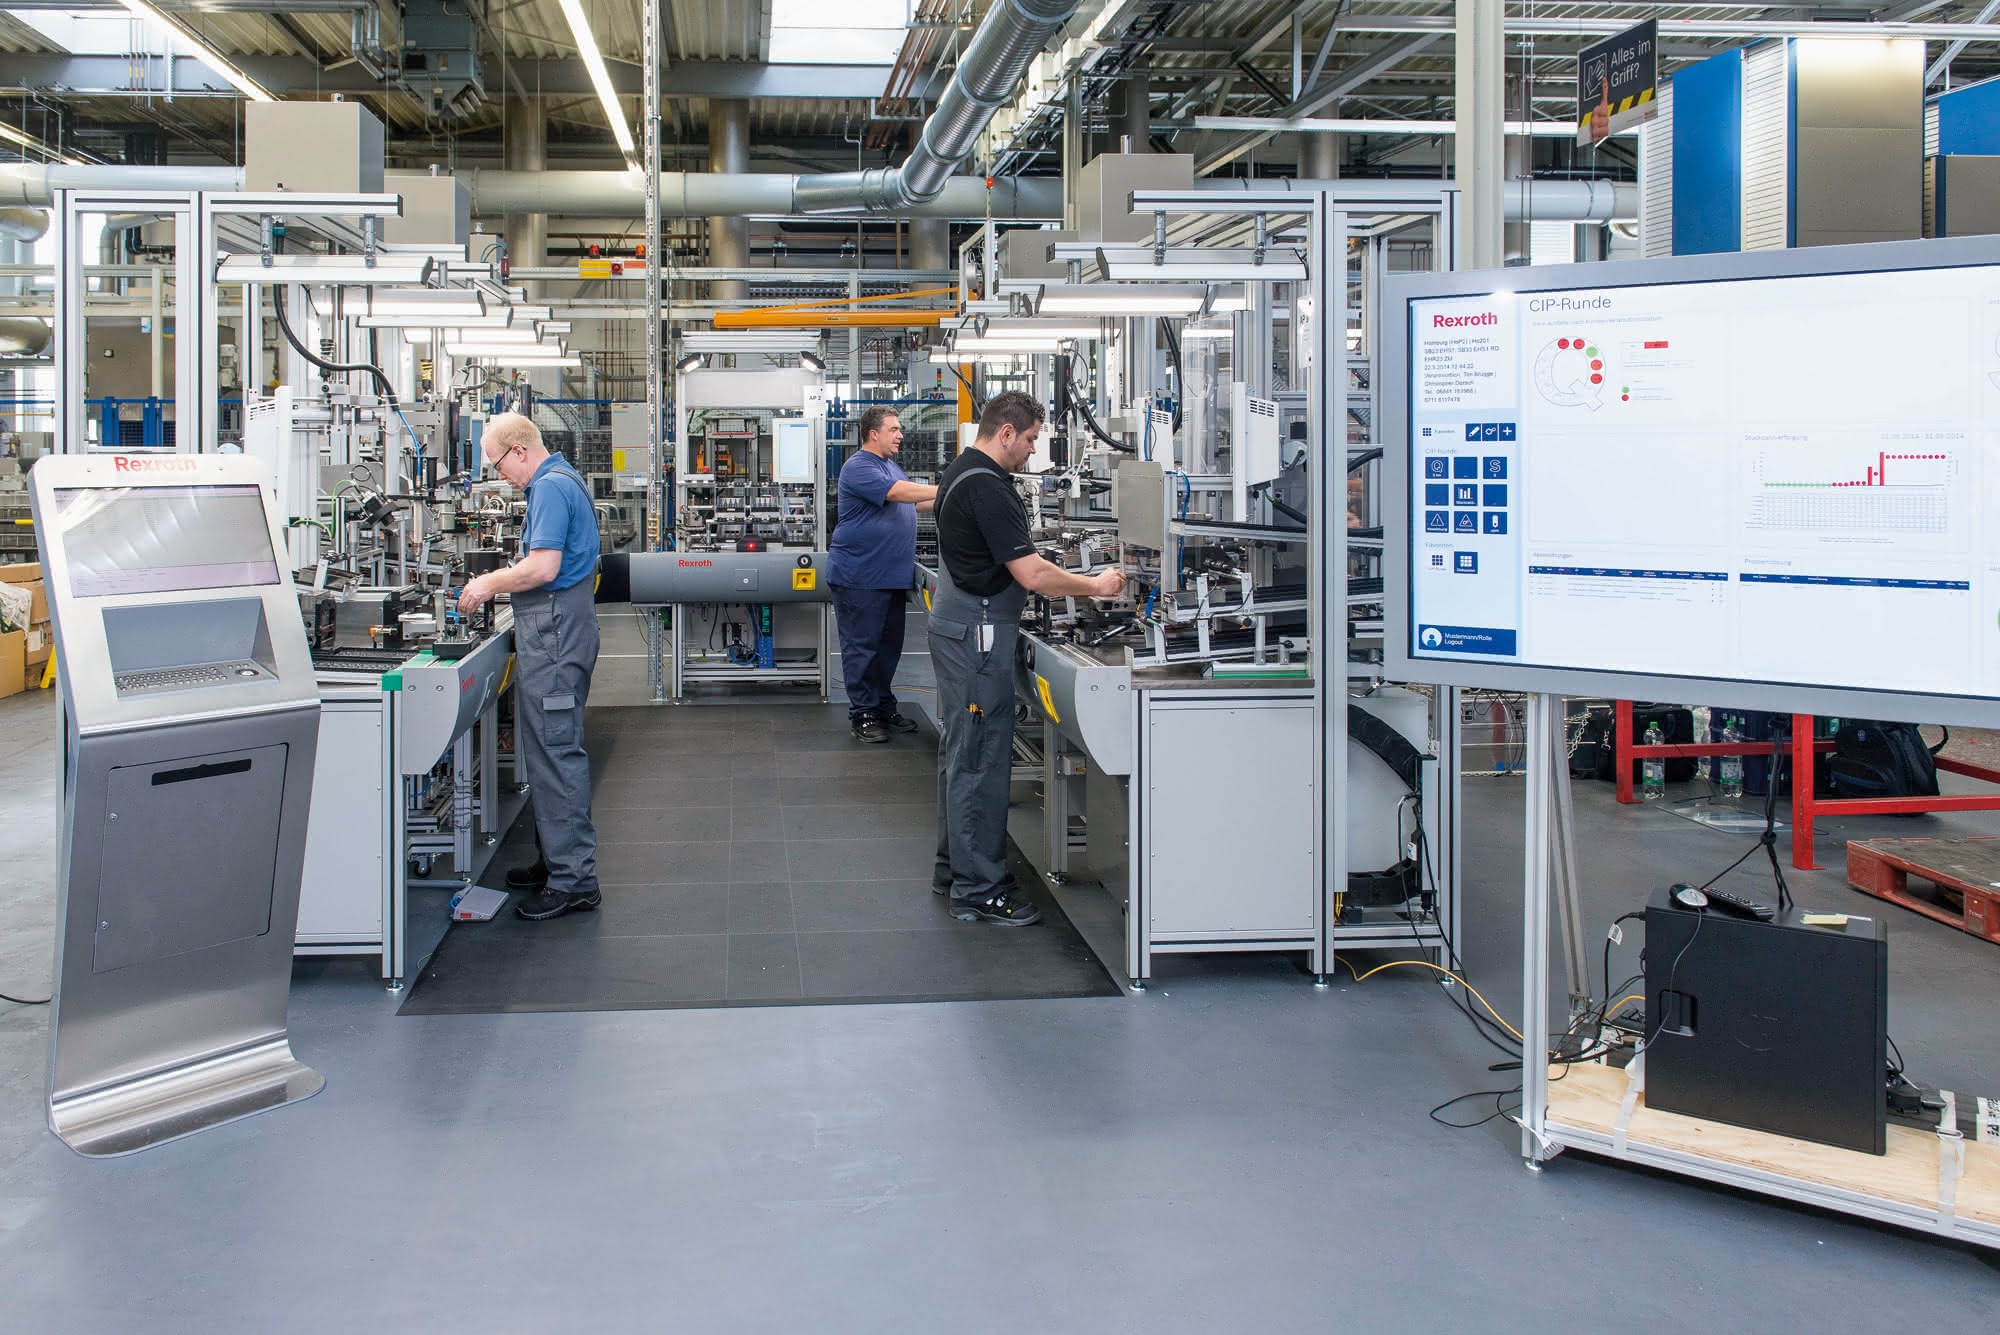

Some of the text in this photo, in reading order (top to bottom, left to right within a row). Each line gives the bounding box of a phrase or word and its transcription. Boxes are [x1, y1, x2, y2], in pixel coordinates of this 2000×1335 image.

[1611, 40, 1651, 68] Alles im
[1610, 62, 1640, 87] Griff?
[1529, 296, 1611, 312] CIP-Runde
[1433, 312, 1498, 328] Rexroth
[113, 456, 199, 472] Rexroth
[678, 559, 712, 567] Rexroth
